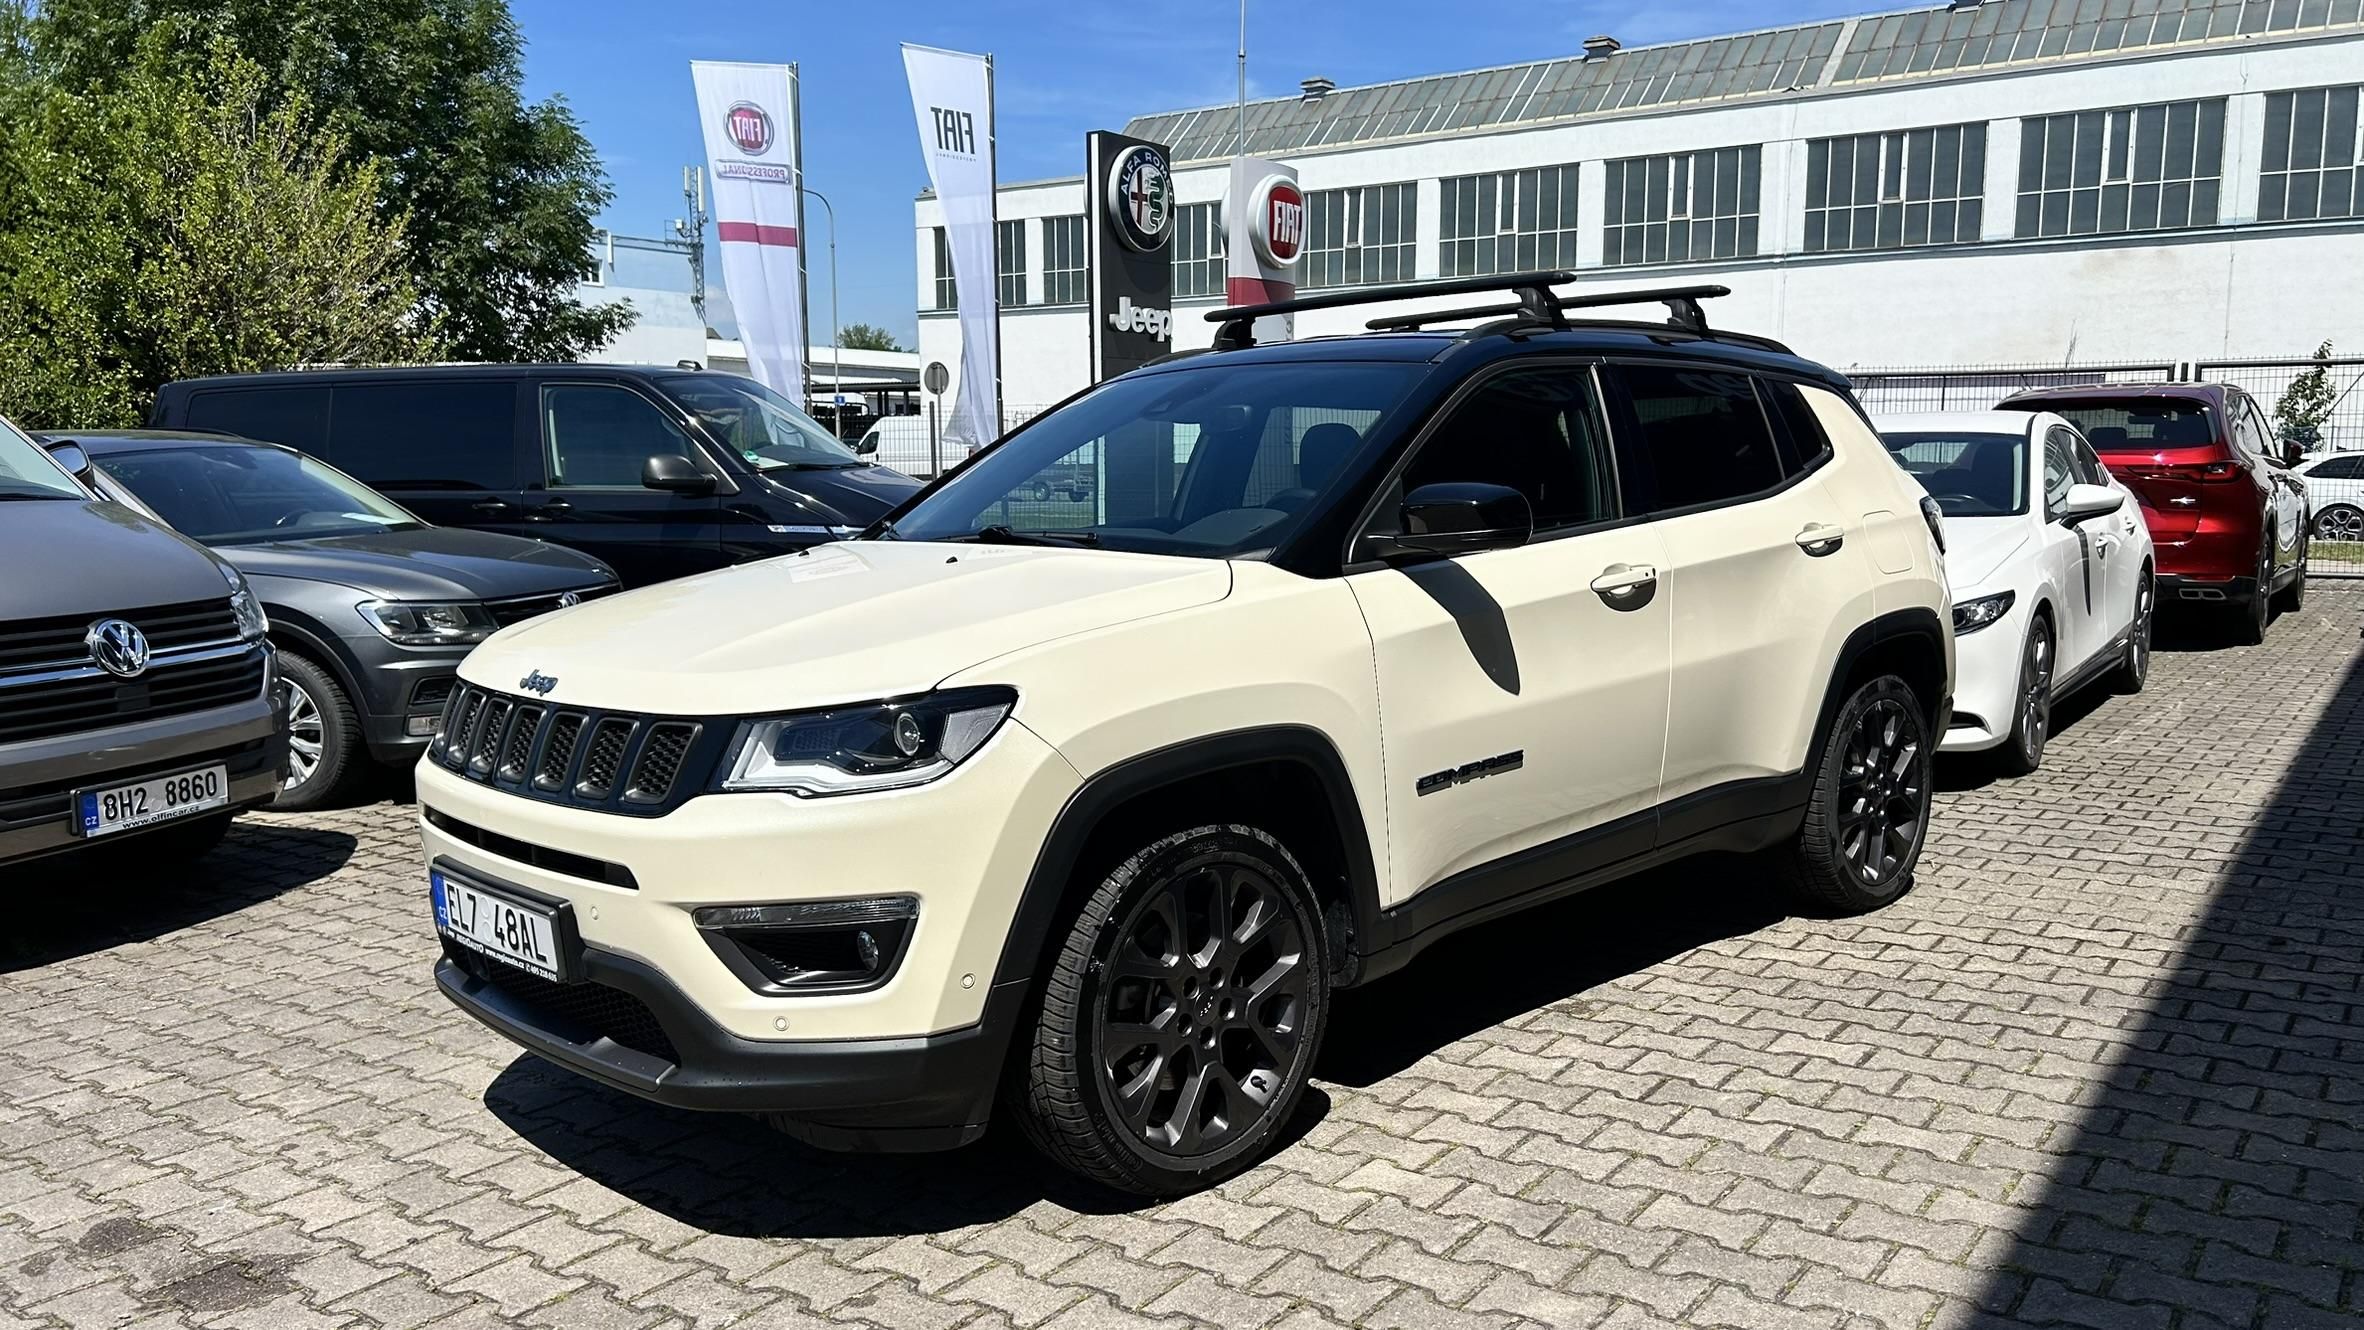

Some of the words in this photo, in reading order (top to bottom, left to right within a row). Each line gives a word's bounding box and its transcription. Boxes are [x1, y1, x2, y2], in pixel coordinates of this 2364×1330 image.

[1121, 155, 1141, 196] ALFA
[1144, 151, 1174, 204] ROMEO
[1273, 200, 1301, 246] FIAT
[1109, 296, 1172, 342] Jeep
[520, 668, 558, 697] Jeep
[103, 787, 149, 821] 8H2
[165, 770, 218, 807] 8860
[121, 804, 201, 829] www.olfincar.cz
[84, 815, 98, 826] CZ
[438, 905, 448, 919] CZ
[446, 883, 477, 935] EL7
[494, 904, 548, 964] 48AL
